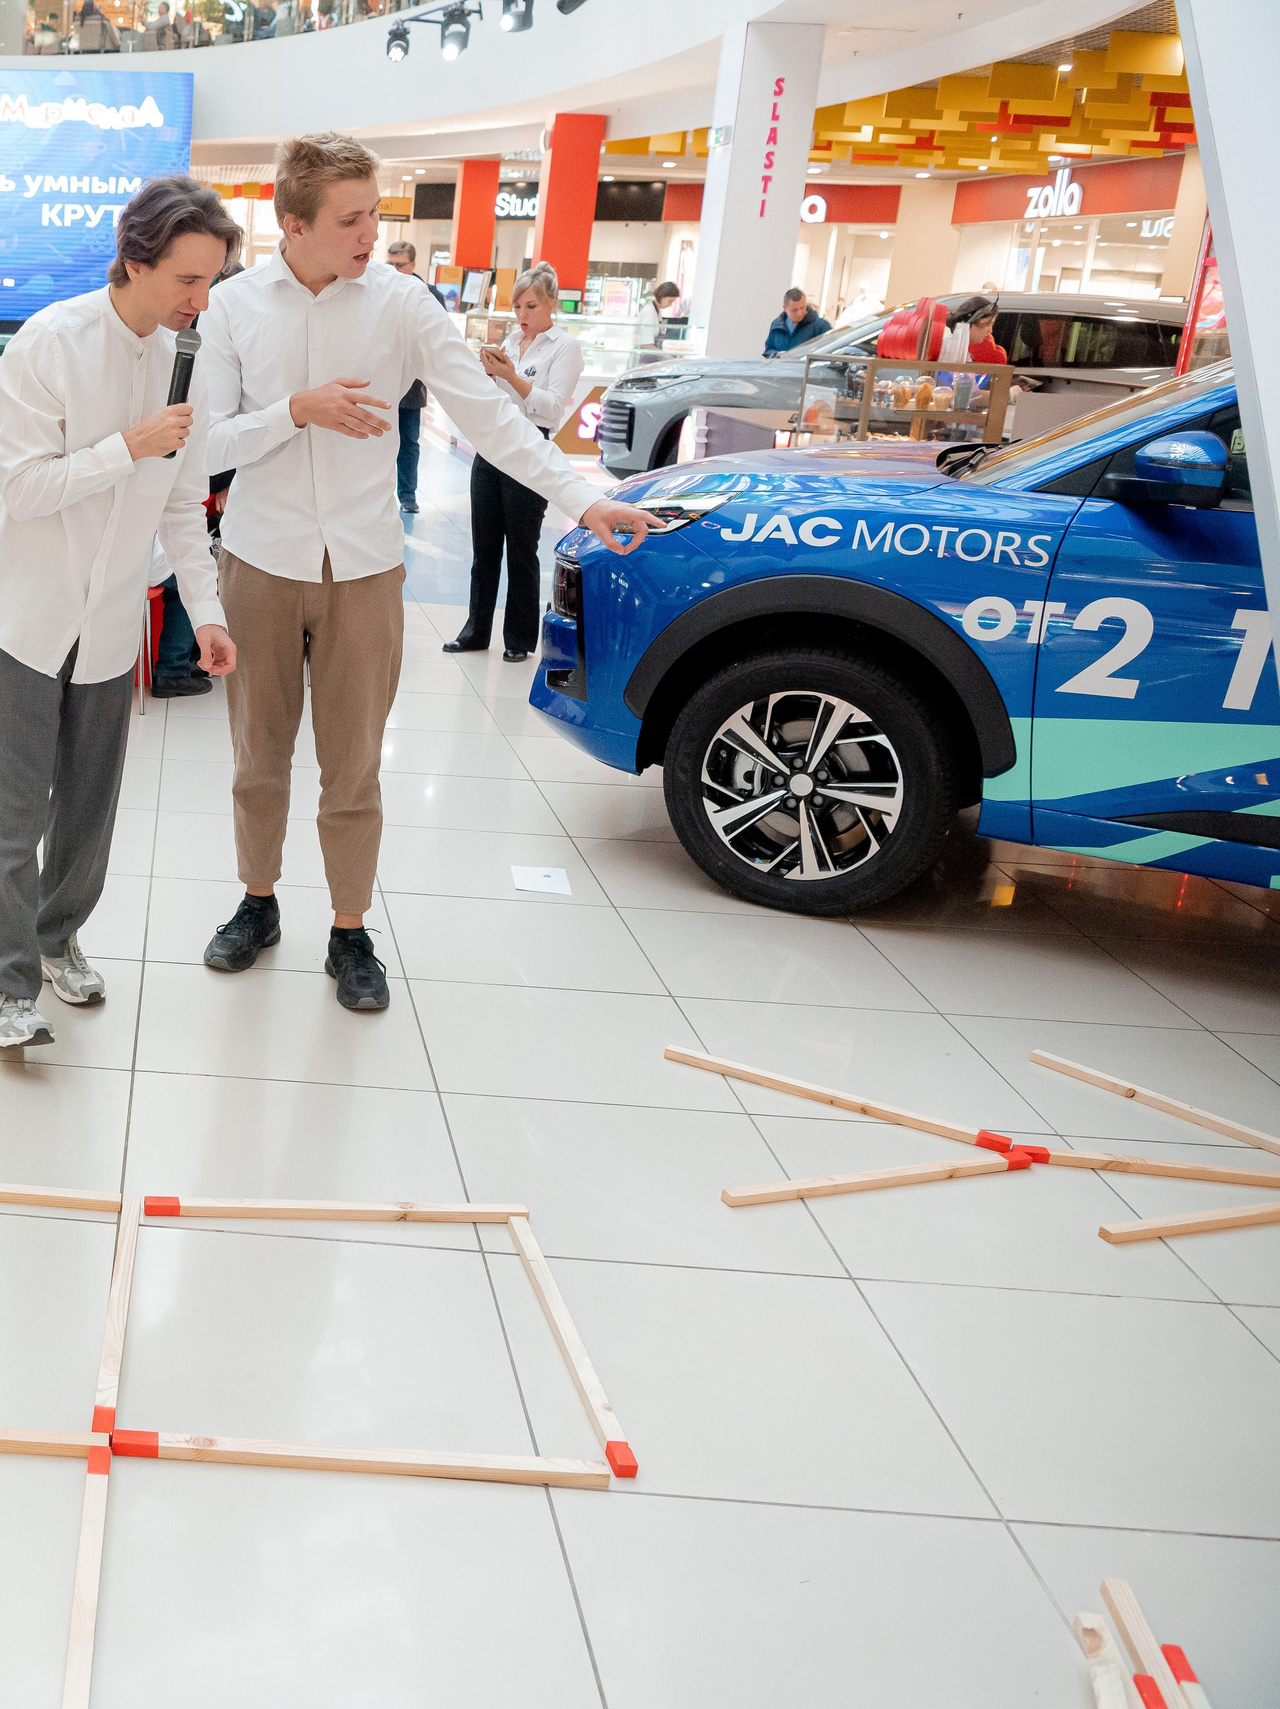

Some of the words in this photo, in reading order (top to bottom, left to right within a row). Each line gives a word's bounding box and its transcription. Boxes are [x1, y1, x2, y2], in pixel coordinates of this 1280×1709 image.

[759, 77, 786, 218] SLASTI
[23, 174, 142, 198] умным
[1024, 168, 1084, 219] zolla
[720, 513, 843, 547] JAC
[851, 520, 1053, 568] MOTORS
